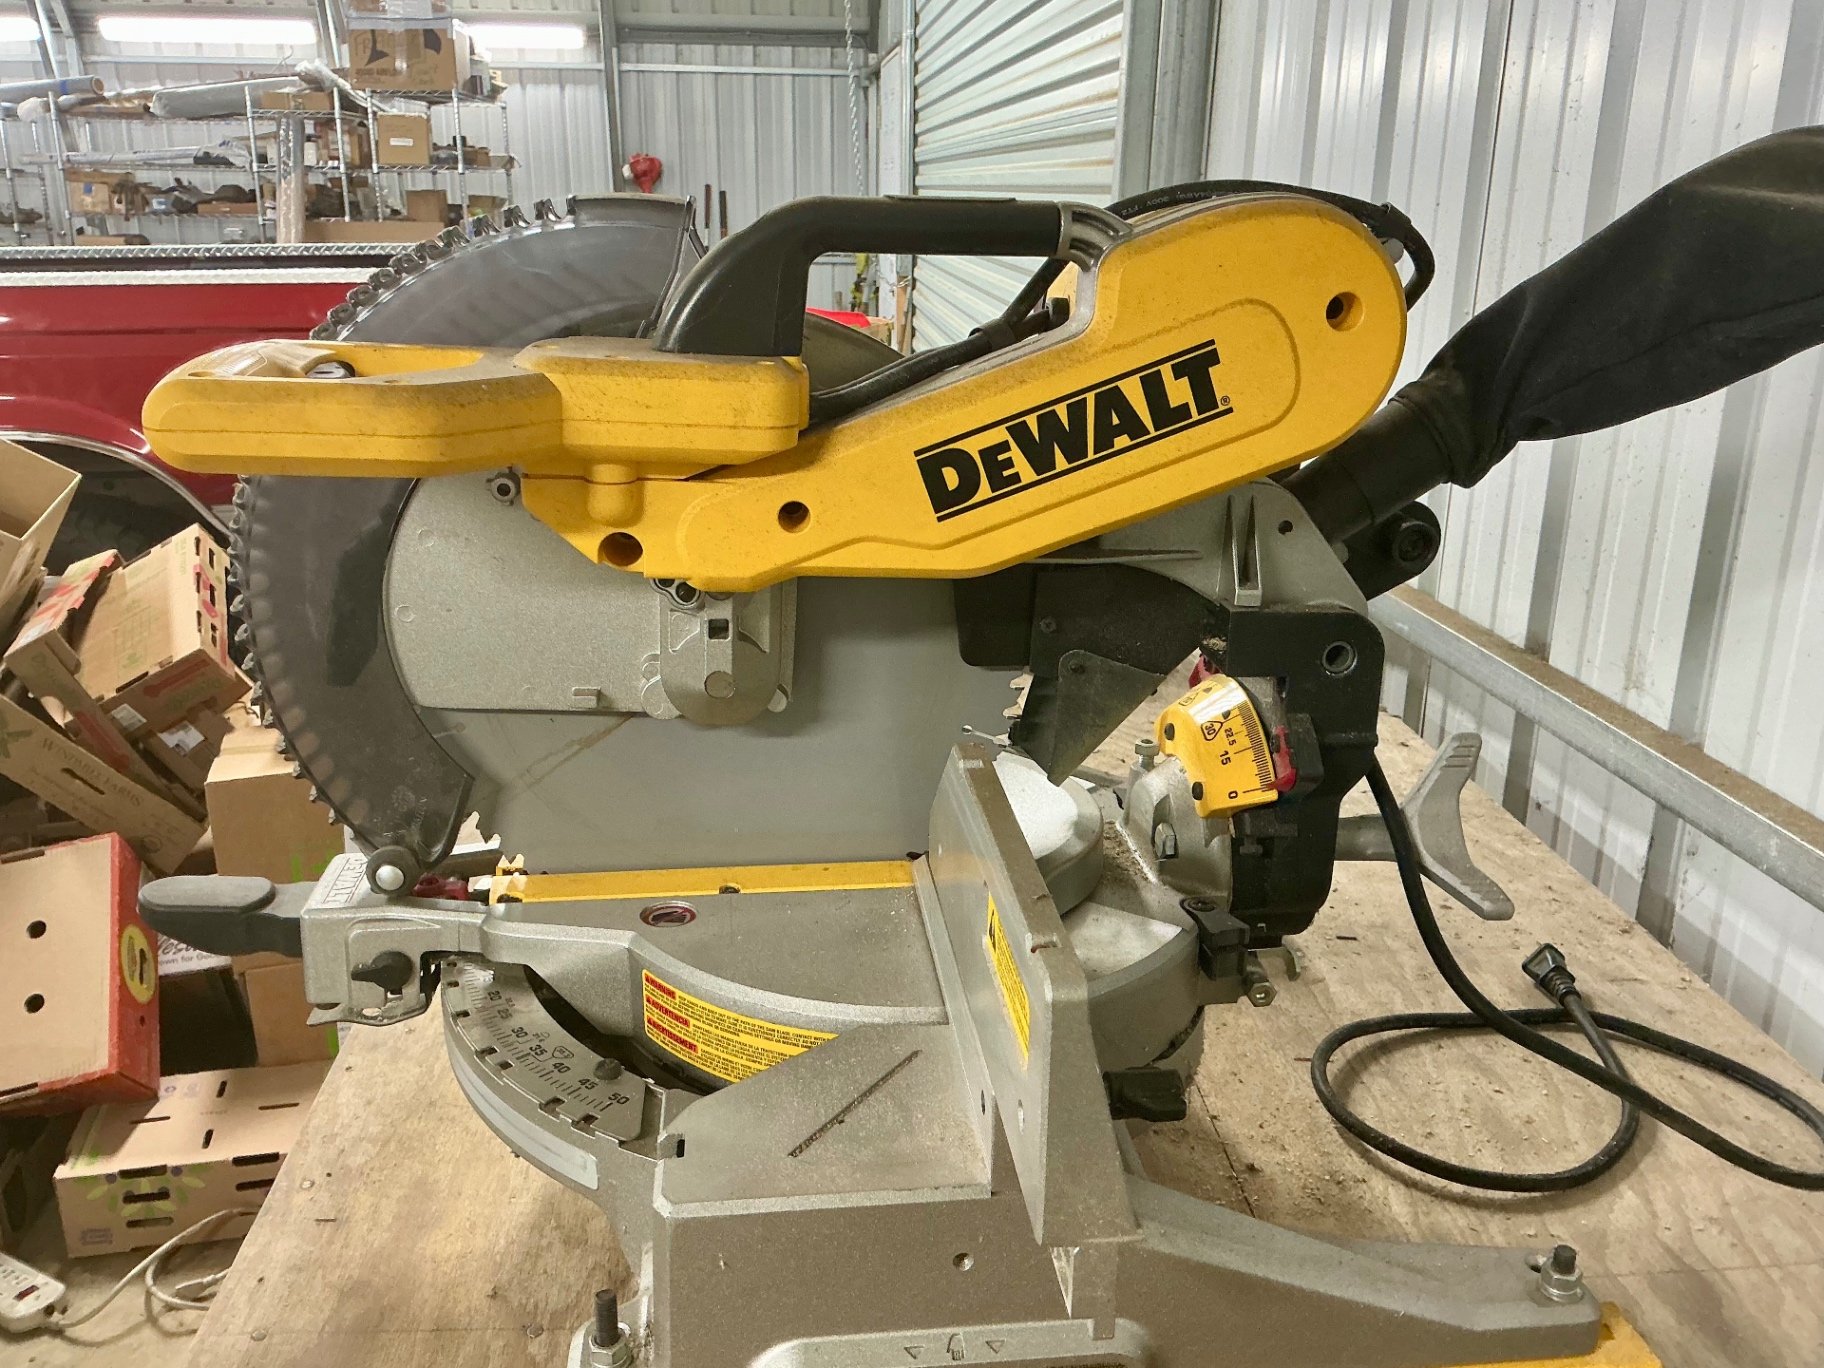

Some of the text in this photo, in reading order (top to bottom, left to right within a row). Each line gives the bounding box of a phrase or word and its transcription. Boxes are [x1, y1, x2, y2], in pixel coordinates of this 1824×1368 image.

[916, 348, 1221, 515] DEWALT
[1205, 723, 1216, 736] 30
[1224, 727, 1237, 746] 22.5
[1220, 750, 1232, 766] 15
[1228, 790, 1239, 800] 0
[487, 989, 502, 1002] 20
[497, 1008, 513, 1020] 25
[511, 1026, 528, 1039] 30
[529, 1044, 548, 1057] 35
[552, 1062, 571, 1074] 40
[578, 1078, 599, 1090] 45
[608, 1092, 630, 1105] 50
